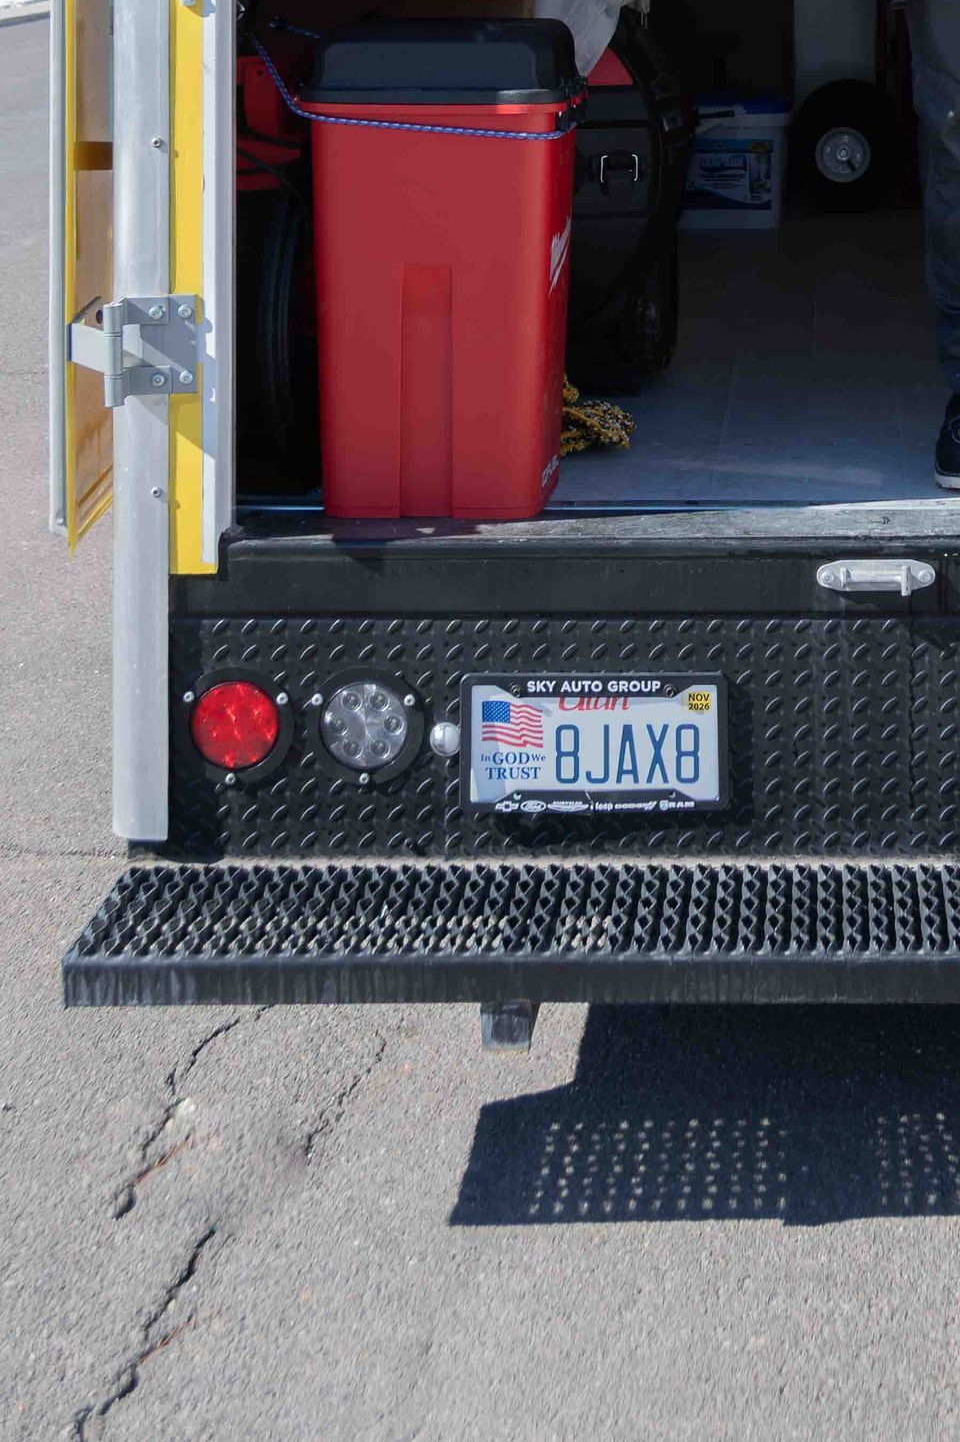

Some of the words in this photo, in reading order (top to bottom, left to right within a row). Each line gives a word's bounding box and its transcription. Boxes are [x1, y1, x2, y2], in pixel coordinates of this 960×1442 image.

[527, 680, 555, 692] SKY
[561, 680, 603, 692] AUTO
[607, 680, 661, 693] GROUP
[688, 693, 710, 702] NOV
[688, 702, 710, 711] 2026
[480, 753, 491, 762] In
[492, 751, 530, 765] GOD
[532, 753, 546, 762] We
[555, 723, 700, 784] 8JAX8
[485, 766, 541, 780] TRUST
